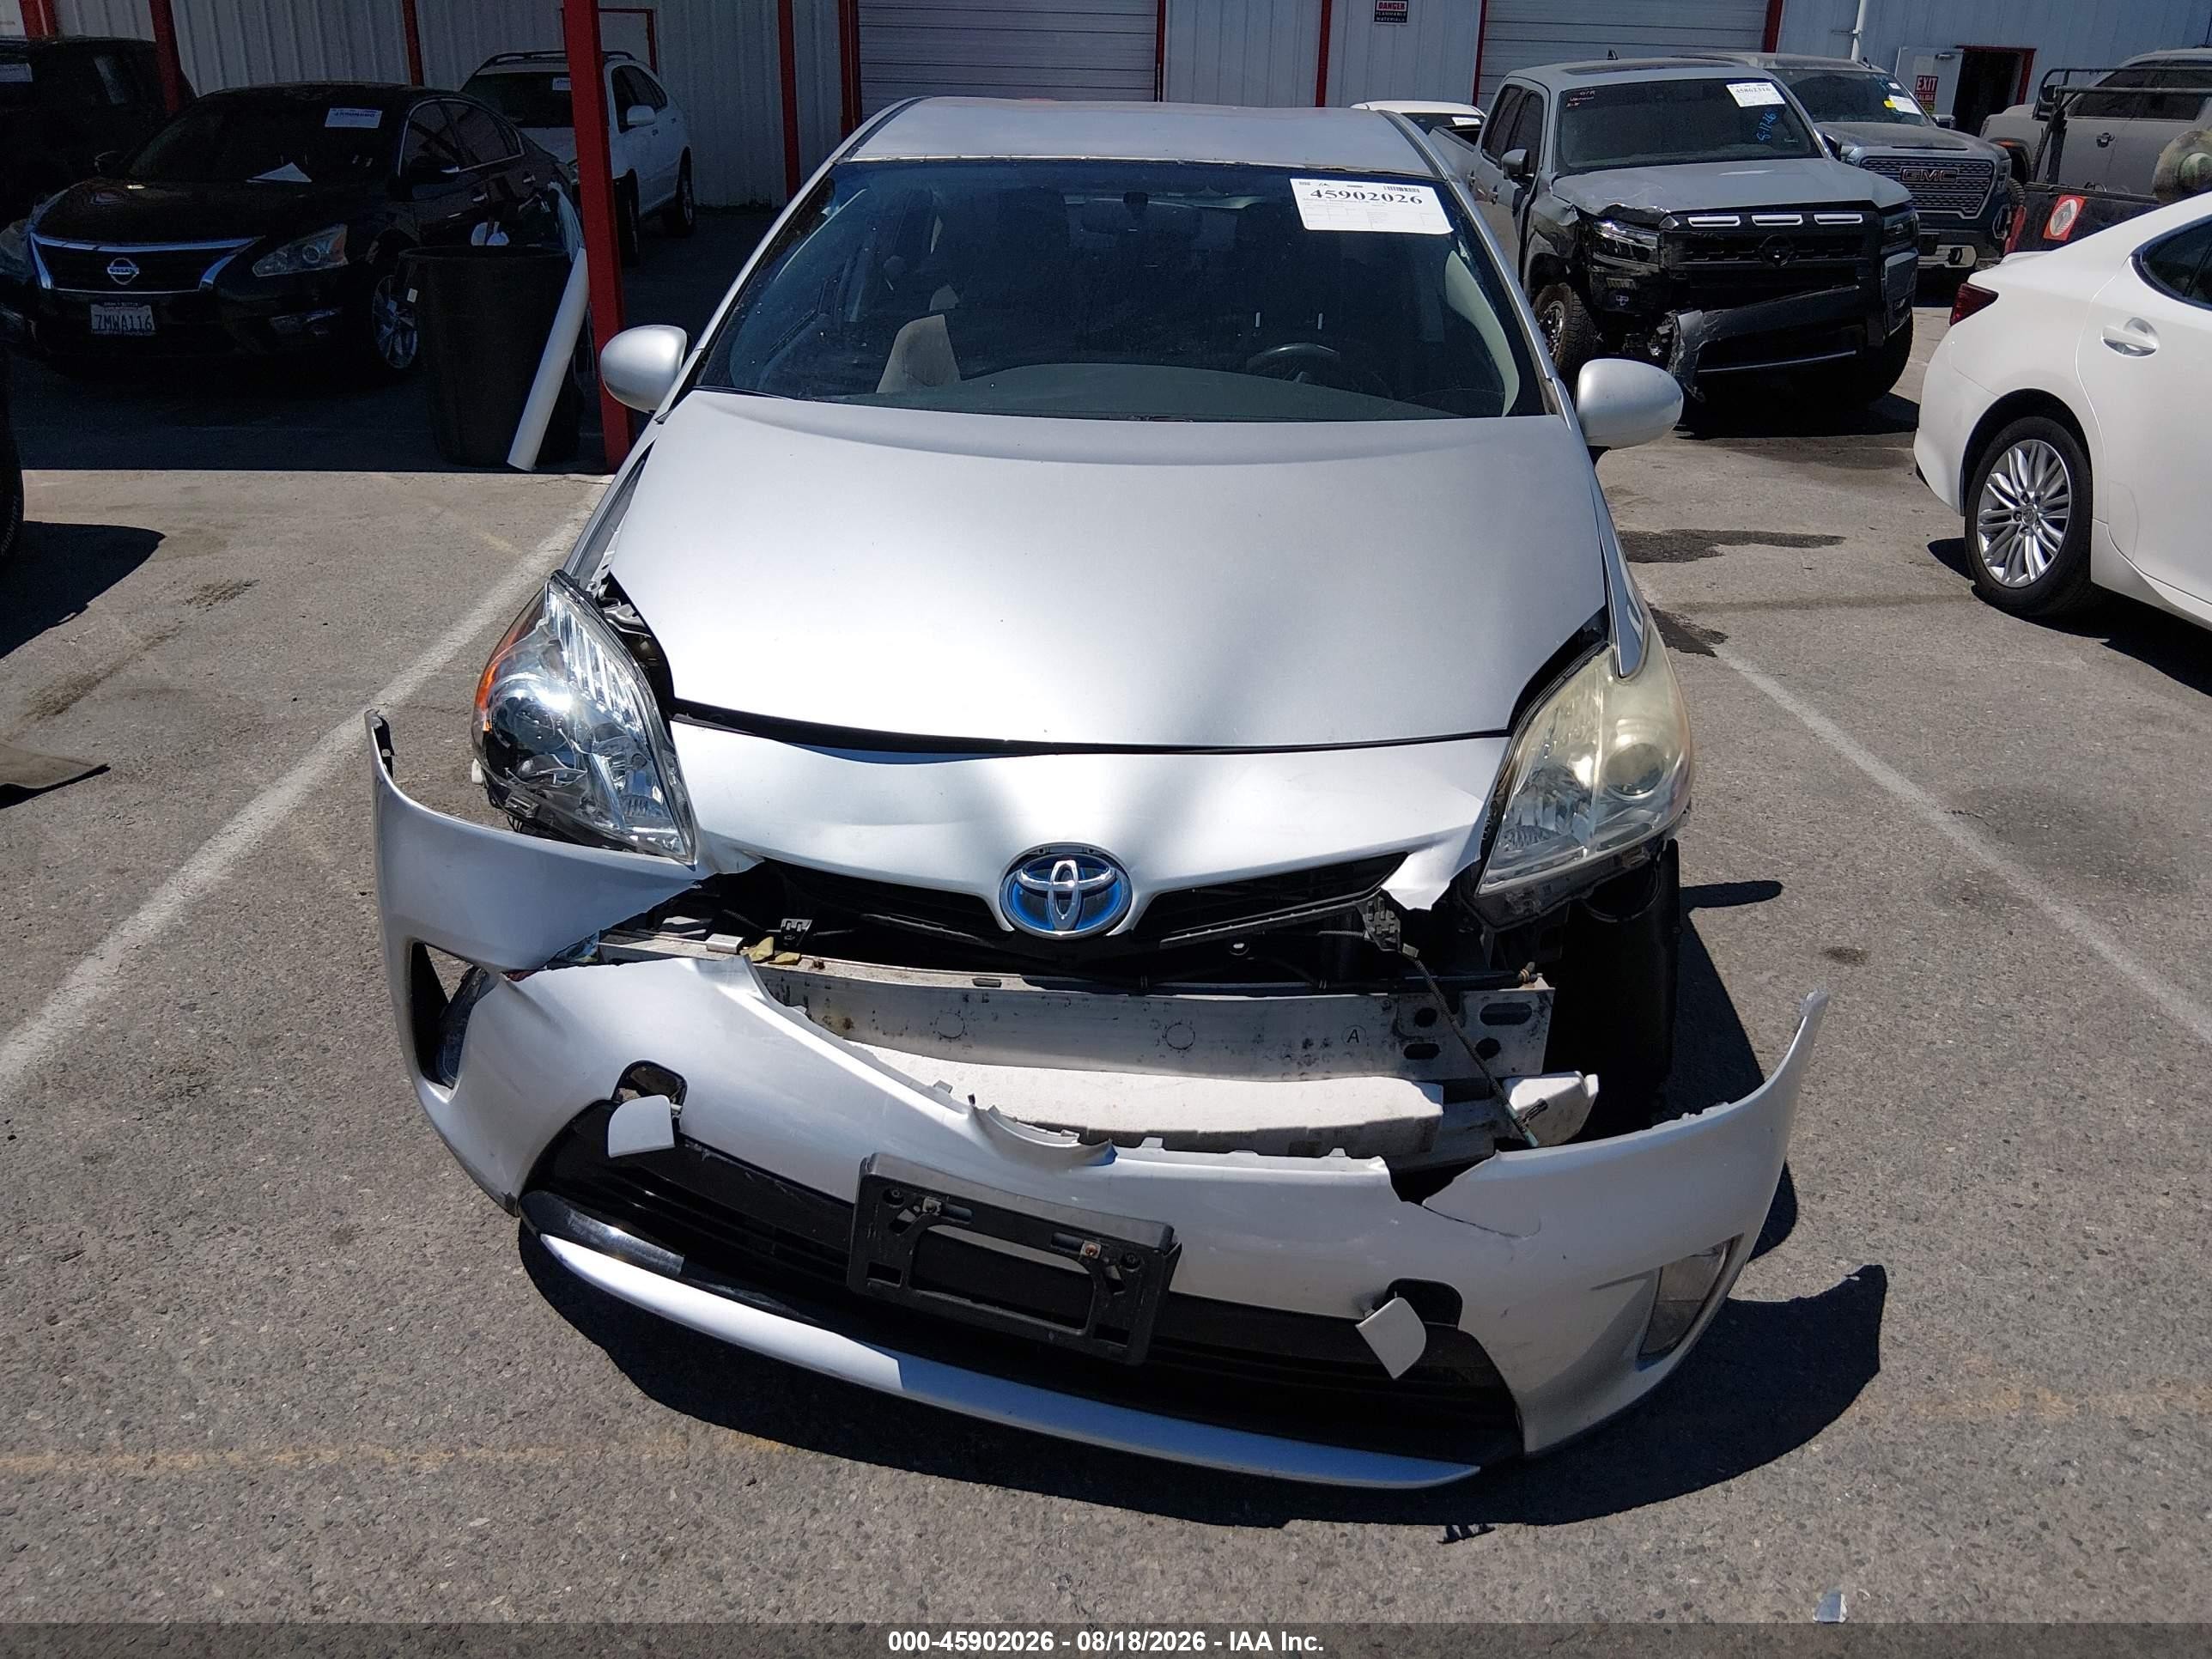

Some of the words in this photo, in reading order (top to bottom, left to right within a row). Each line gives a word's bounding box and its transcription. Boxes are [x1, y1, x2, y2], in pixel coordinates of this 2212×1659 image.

[1378, 2, 1405, 10] DANGER
[1916, 76, 1938, 92] EXIT
[1901, 168, 1958, 183] GMC
[1310, 189, 1423, 205] 45902026
[94, 314, 153, 332] 7MWA116
[1346, 1029, 1360, 1043] A
